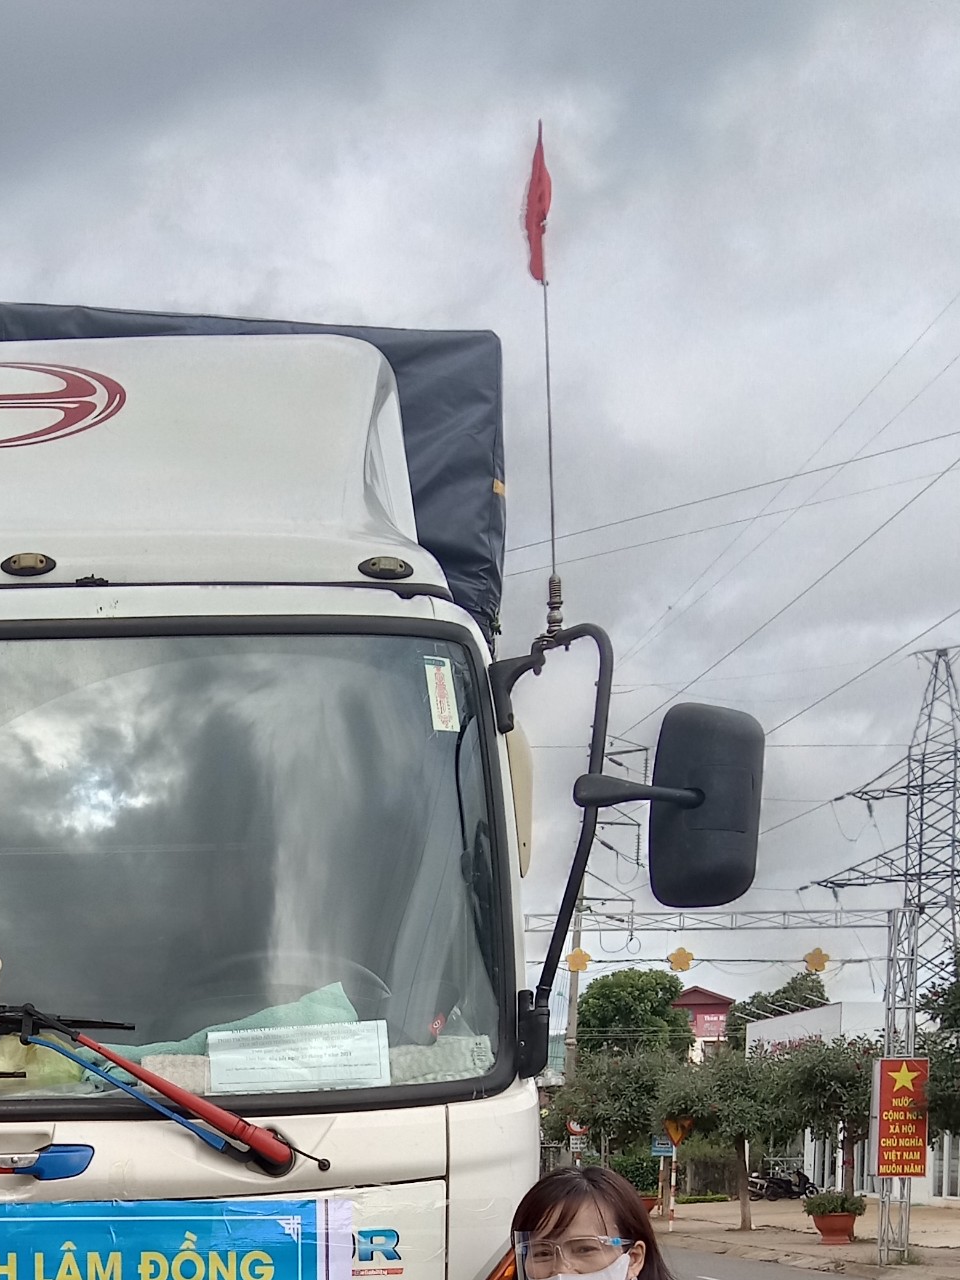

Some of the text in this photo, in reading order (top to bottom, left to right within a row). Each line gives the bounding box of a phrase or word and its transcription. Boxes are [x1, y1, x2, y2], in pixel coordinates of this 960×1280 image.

[883, 1110, 904, 1122] CỘNG
[901, 1123, 916, 1135] HỘI
[881, 1136, 897, 1147] CHỦ
[883, 1150, 920, 1162] VIỆT NAM
[880, 1162, 902, 1174] MUÔN
